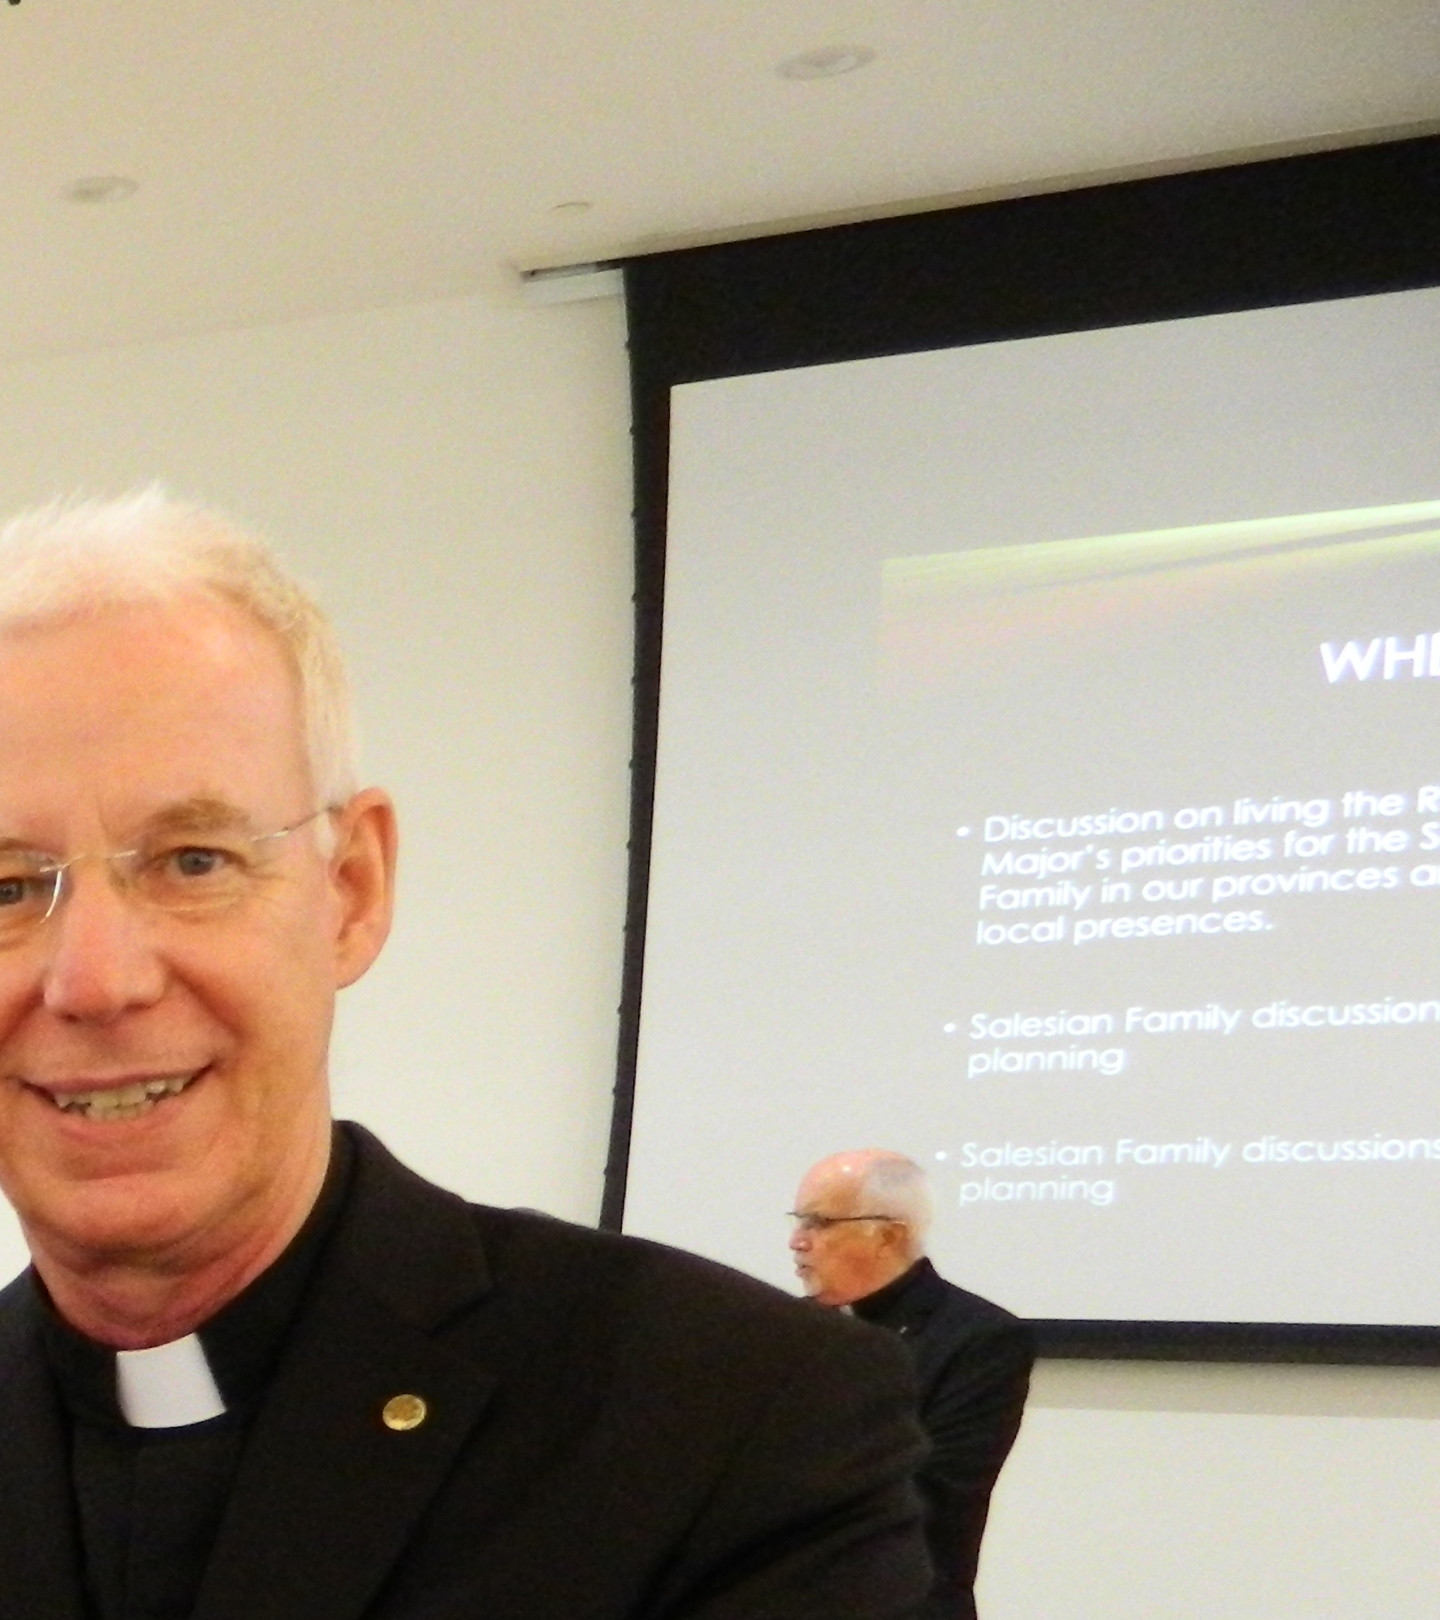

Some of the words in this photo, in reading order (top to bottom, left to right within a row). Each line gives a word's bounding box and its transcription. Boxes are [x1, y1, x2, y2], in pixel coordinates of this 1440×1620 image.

[984, 807, 1165, 842] Discussion
[1174, 806, 1223, 830] on
[1233, 796, 1331, 828] living
[1342, 790, 1407, 818] the
[981, 844, 1112, 879] Major's
[1121, 835, 1272, 873] priorities
[1283, 829, 1337, 857] for
[1346, 826, 1410, 854] the
[979, 880, 1092, 911] Family
[1101, 877, 1132, 903] in
[1142, 877, 1205, 901] our
[1212, 865, 1400, 903] provinces
[1409, 864, 1440, 887] a
[976, 915, 1067, 945] local
[1074, 910, 1274, 945] presences.
[970, 1009, 1114, 1040] Salesian
[1125, 1003, 1243, 1035] Family
[968, 1044, 1126, 1079] planning
[961, 1140, 1103, 1168] Salesian
[1116, 1136, 1231, 1169] Family
[959, 1174, 1116, 1206] planning
